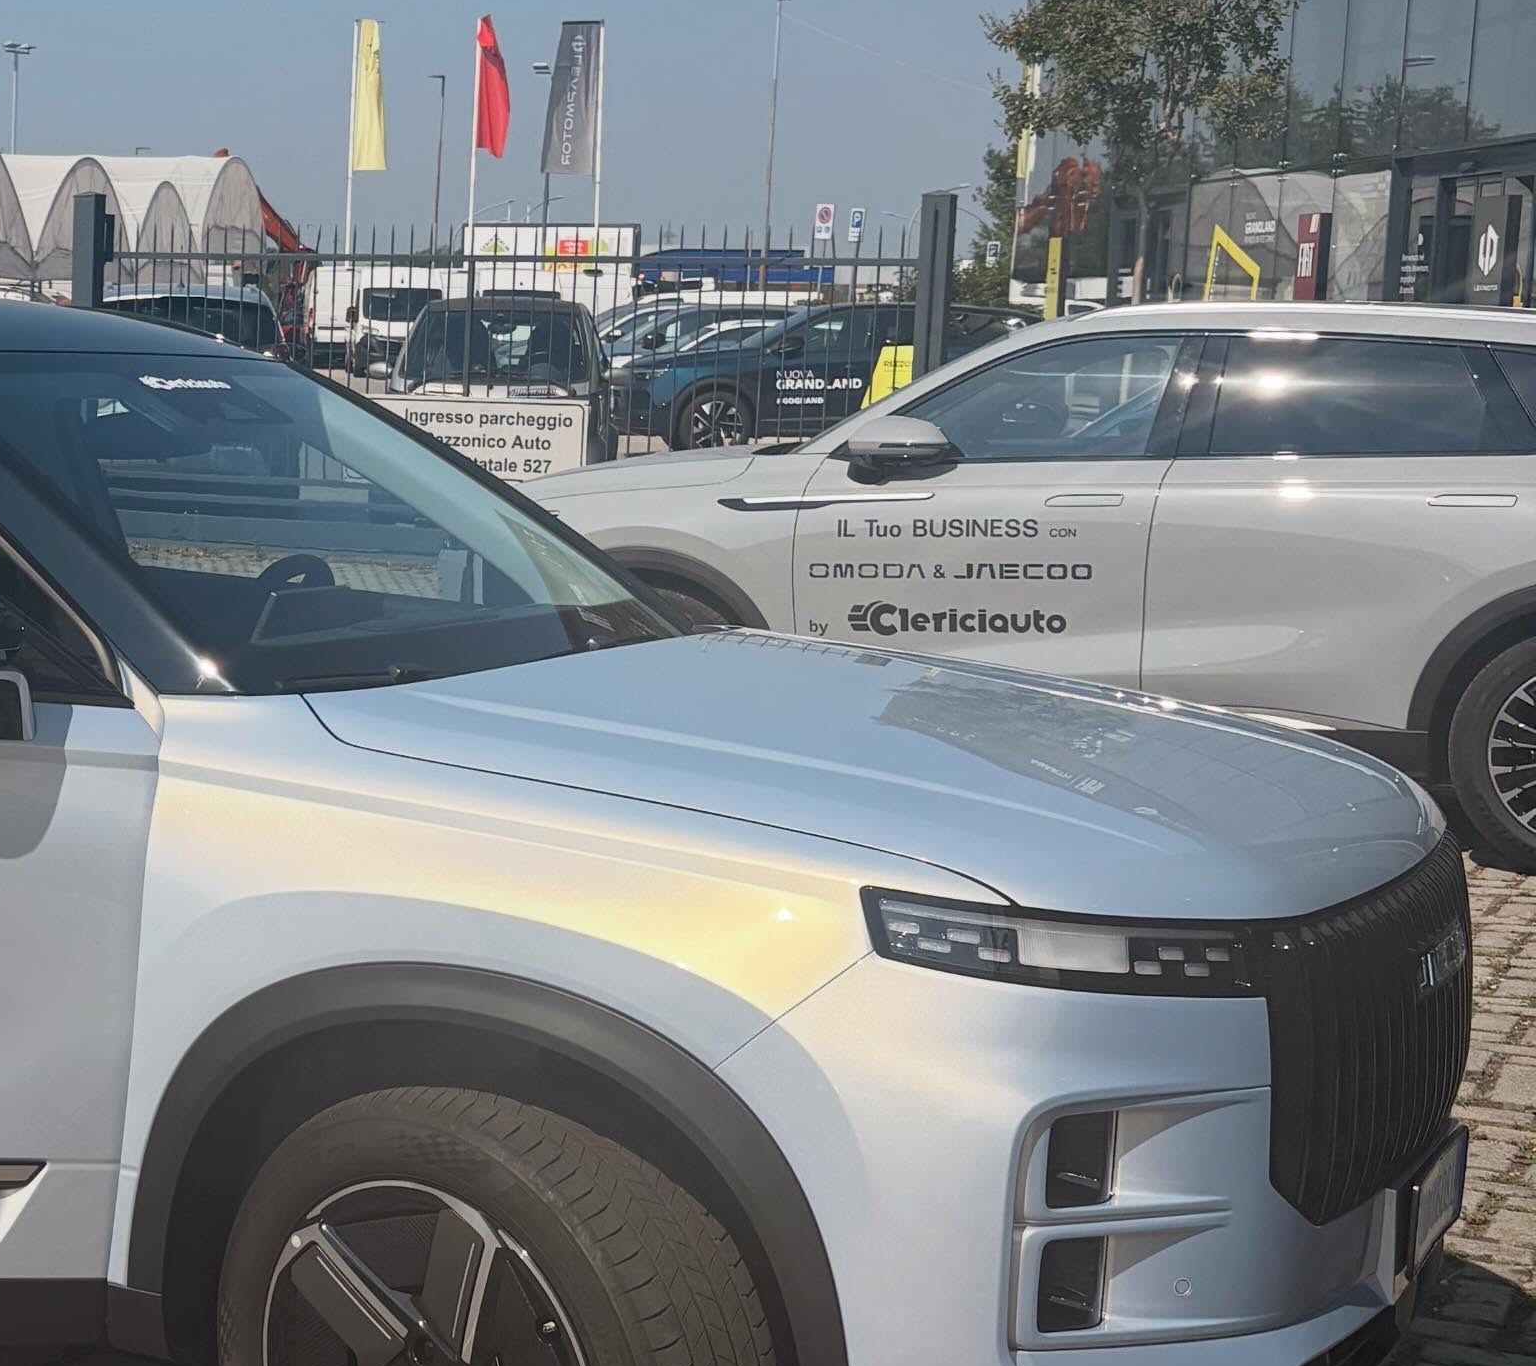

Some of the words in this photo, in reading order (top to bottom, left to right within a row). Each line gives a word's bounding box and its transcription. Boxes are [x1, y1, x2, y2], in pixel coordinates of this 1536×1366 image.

[1296, 242, 1315, 278] FIAT
[405, 408, 474, 426] Ingresso
[479, 412, 573, 431] parcheggio
[434, 434, 506, 449] ezzonico
[511, 435, 552, 451] Auto
[470, 457, 518, 473] tatale
[522, 459, 552, 474] 527
[837, 518, 856, 538] IL
[864, 519, 902, 538] Tuo
[911, 518, 1039, 538] BUSINESS
[1049, 528, 1077, 538] CON
[809, 562, 926, 580] OMODA
[933, 564, 946, 579] &
[954, 562, 1093, 580] JAECOO
[809, 618, 829, 636] by
[867, 601, 1067, 635] Clericiauto
